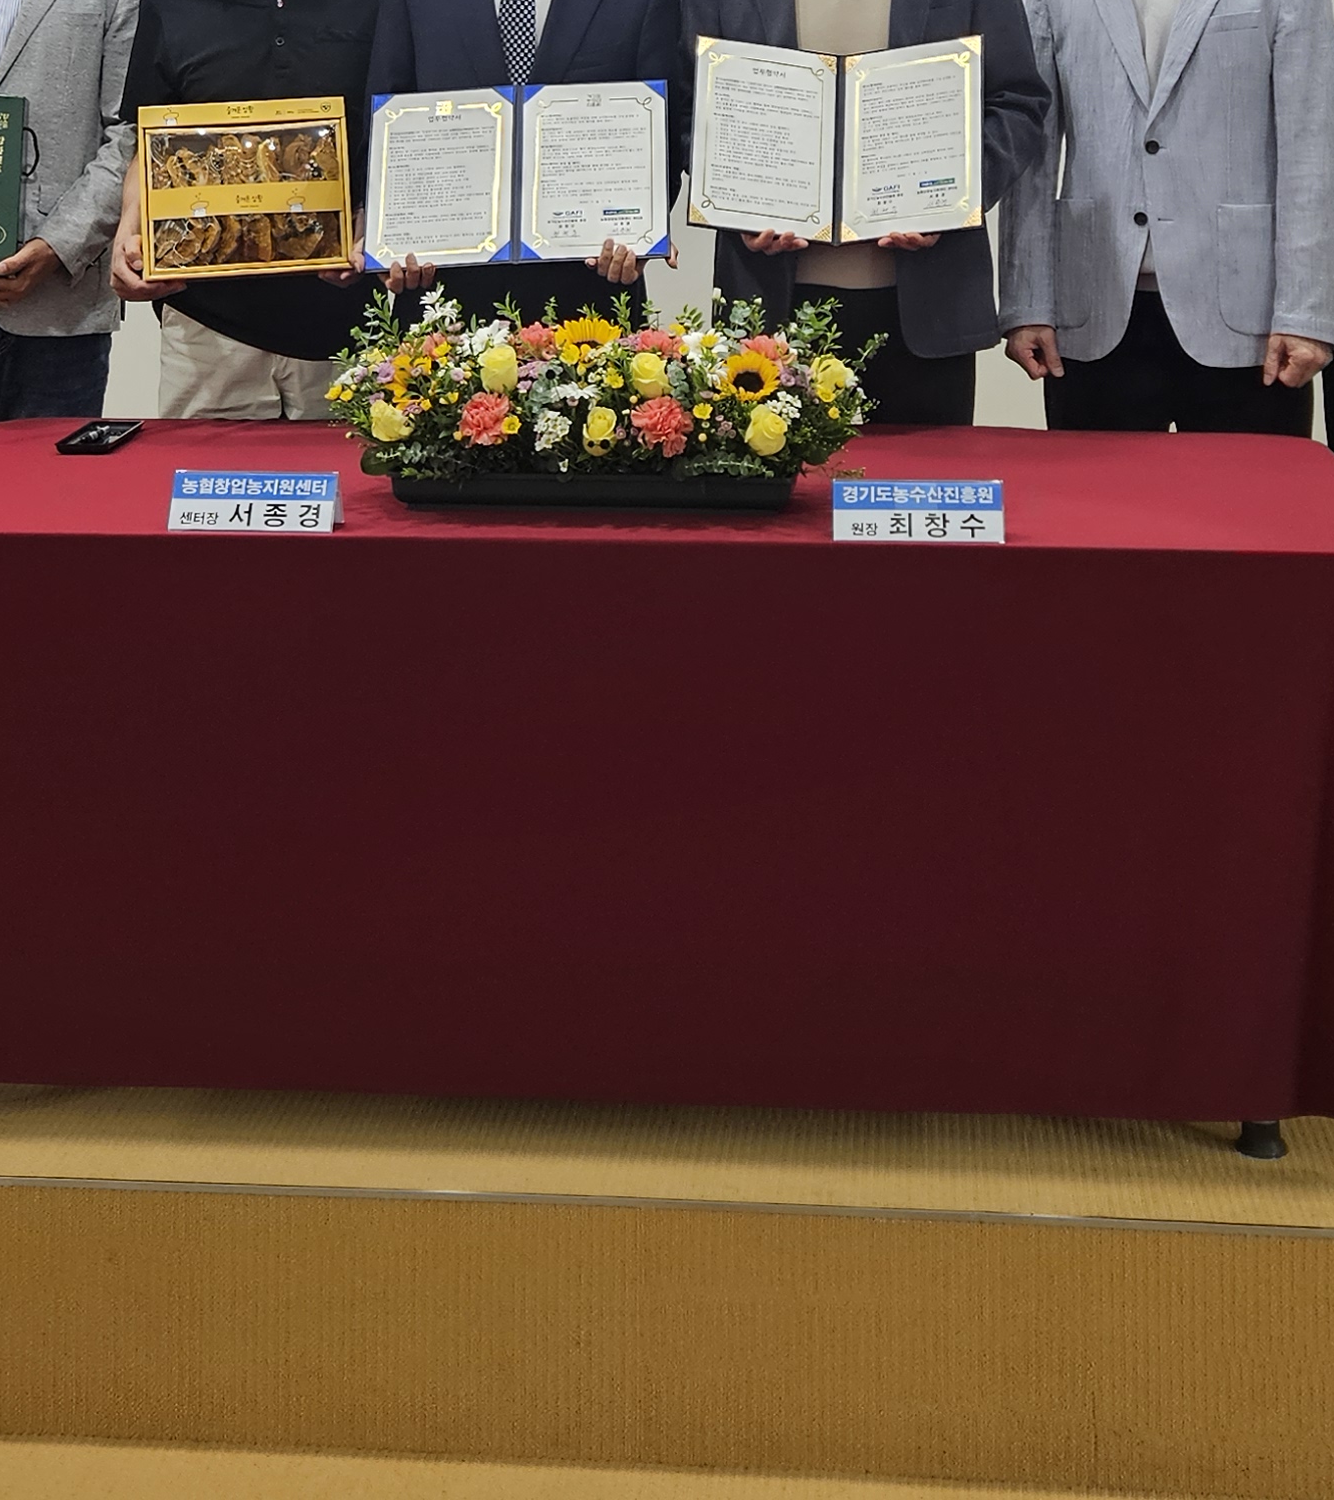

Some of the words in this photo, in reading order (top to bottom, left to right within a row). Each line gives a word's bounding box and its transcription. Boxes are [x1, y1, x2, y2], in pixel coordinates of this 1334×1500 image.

[181, 477, 328, 496] 농협창업농지원센터
[842, 485, 994, 504] 경기도농수산진흥원
[179, 511, 219, 525] 센터장
[851, 522, 878, 537] 원장
